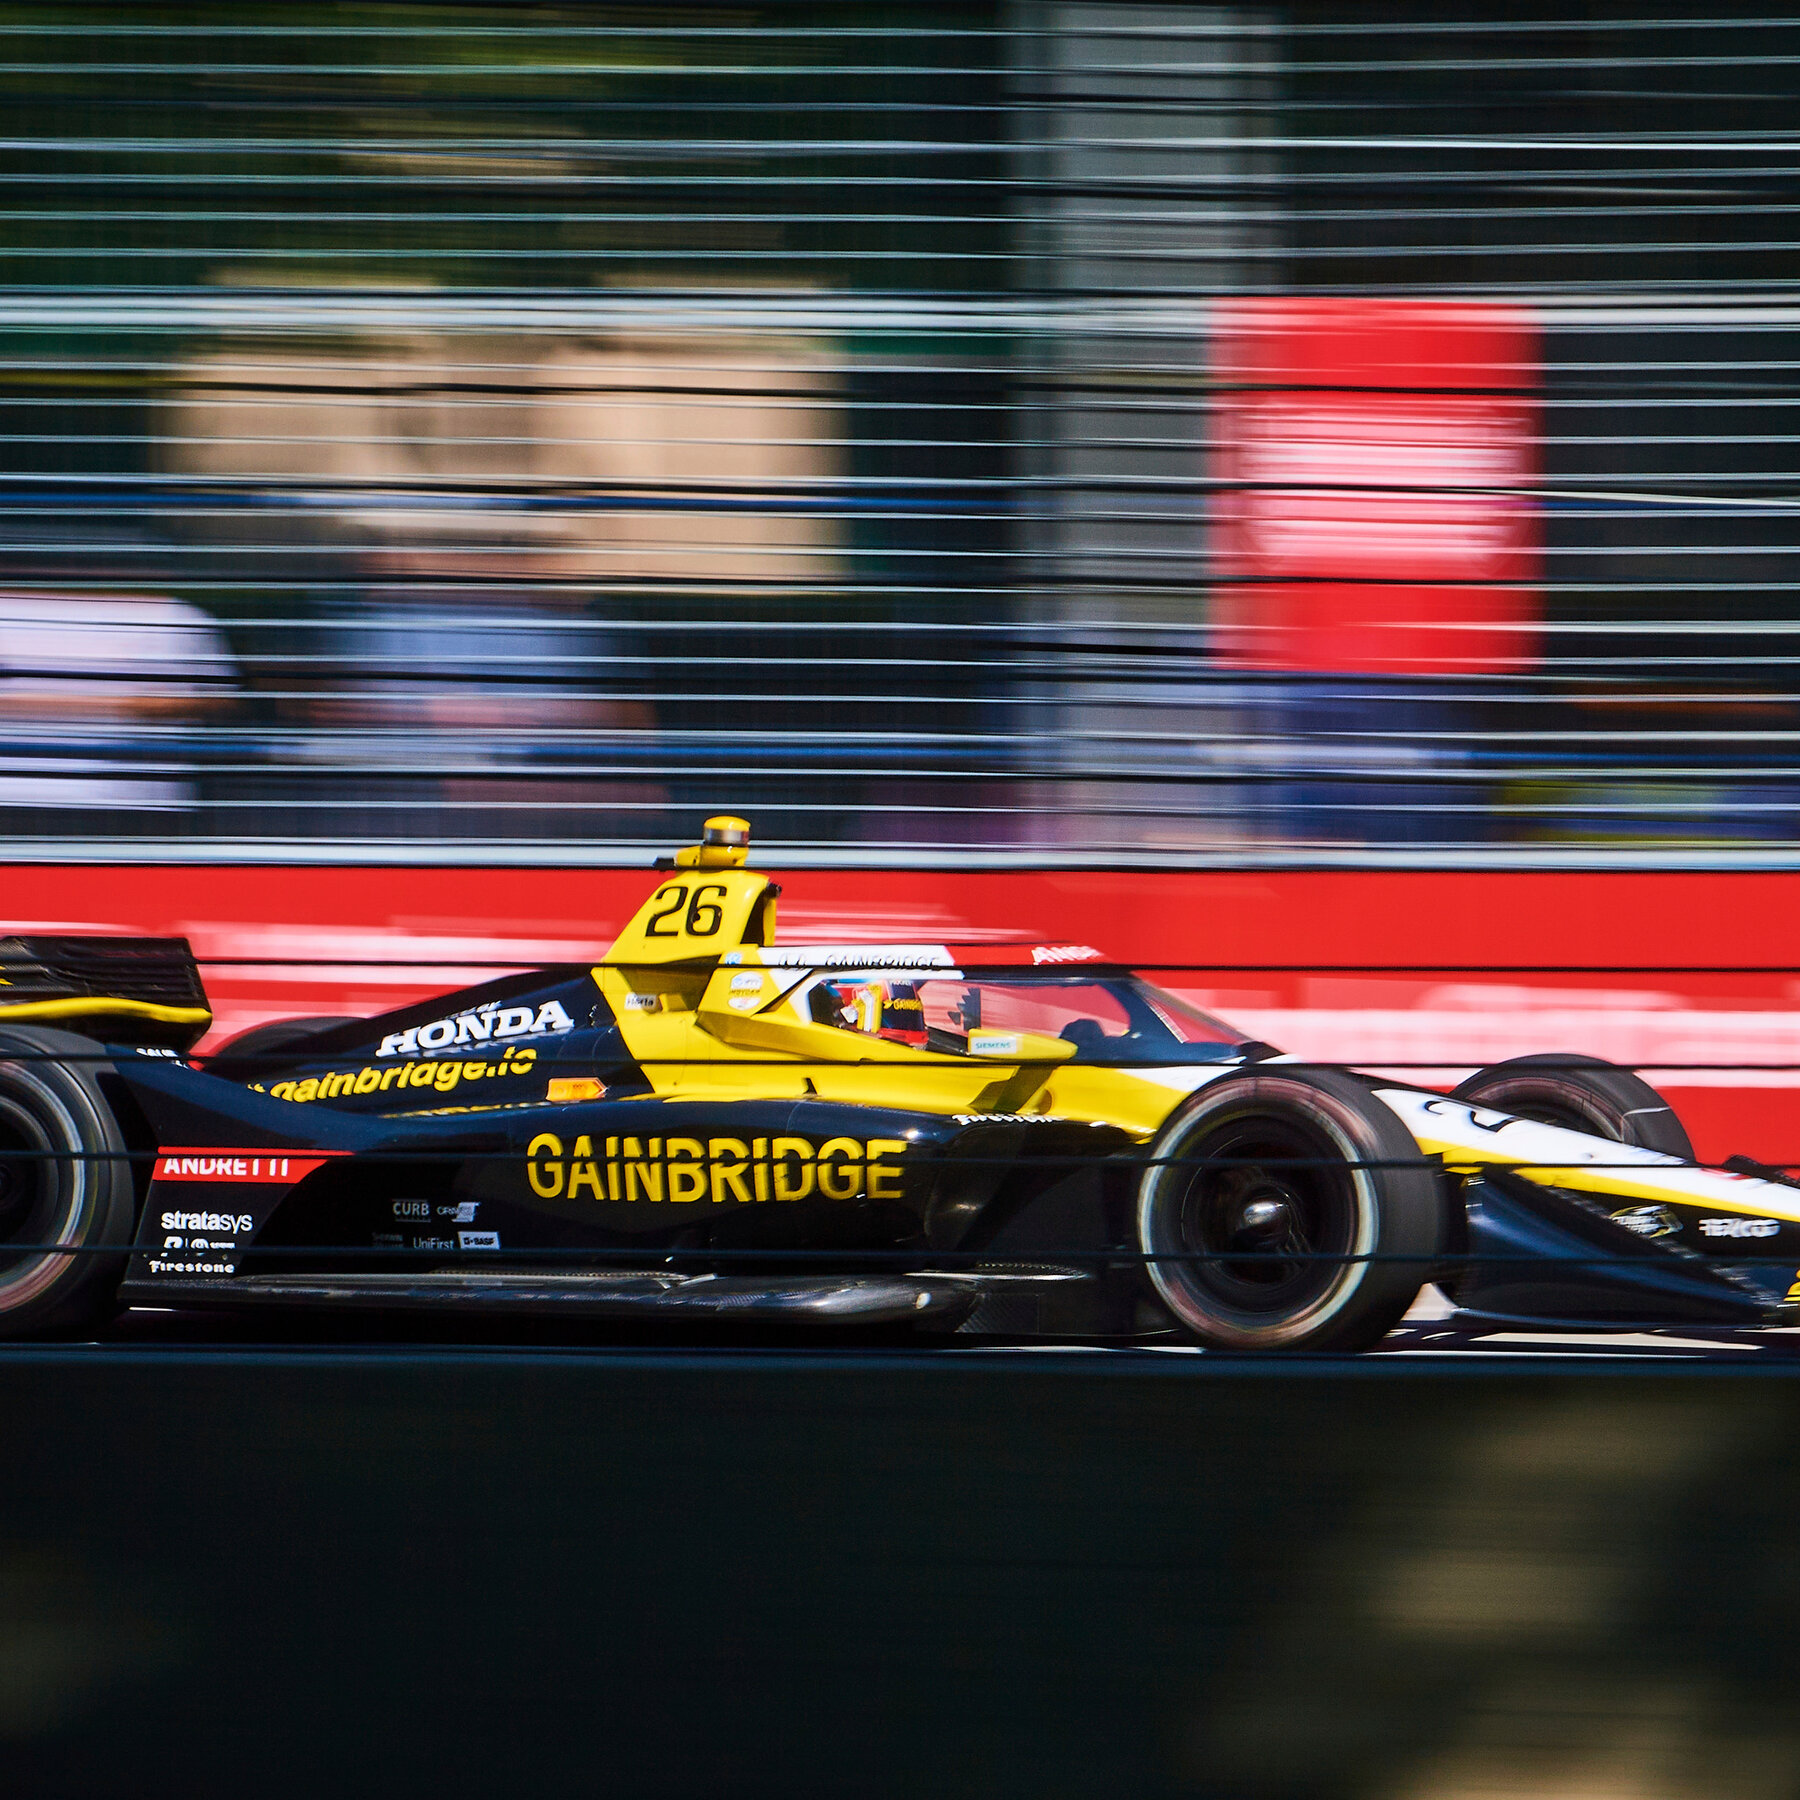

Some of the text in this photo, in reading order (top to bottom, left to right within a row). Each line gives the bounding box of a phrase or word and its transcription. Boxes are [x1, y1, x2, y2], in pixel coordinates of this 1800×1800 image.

[645, 885, 728, 937] 26
[376, 1000, 575, 1057] HONDA
[975, 1041, 1011, 1049] SIEMENS
[527, 1133, 908, 1203] GAINBRIDGE
[392, 1202, 430, 1216] CURB
[161, 1210, 253, 1234] stratasys
[413, 1237, 454, 1249] UniFirst
[149, 1260, 235, 1274] Firestone
